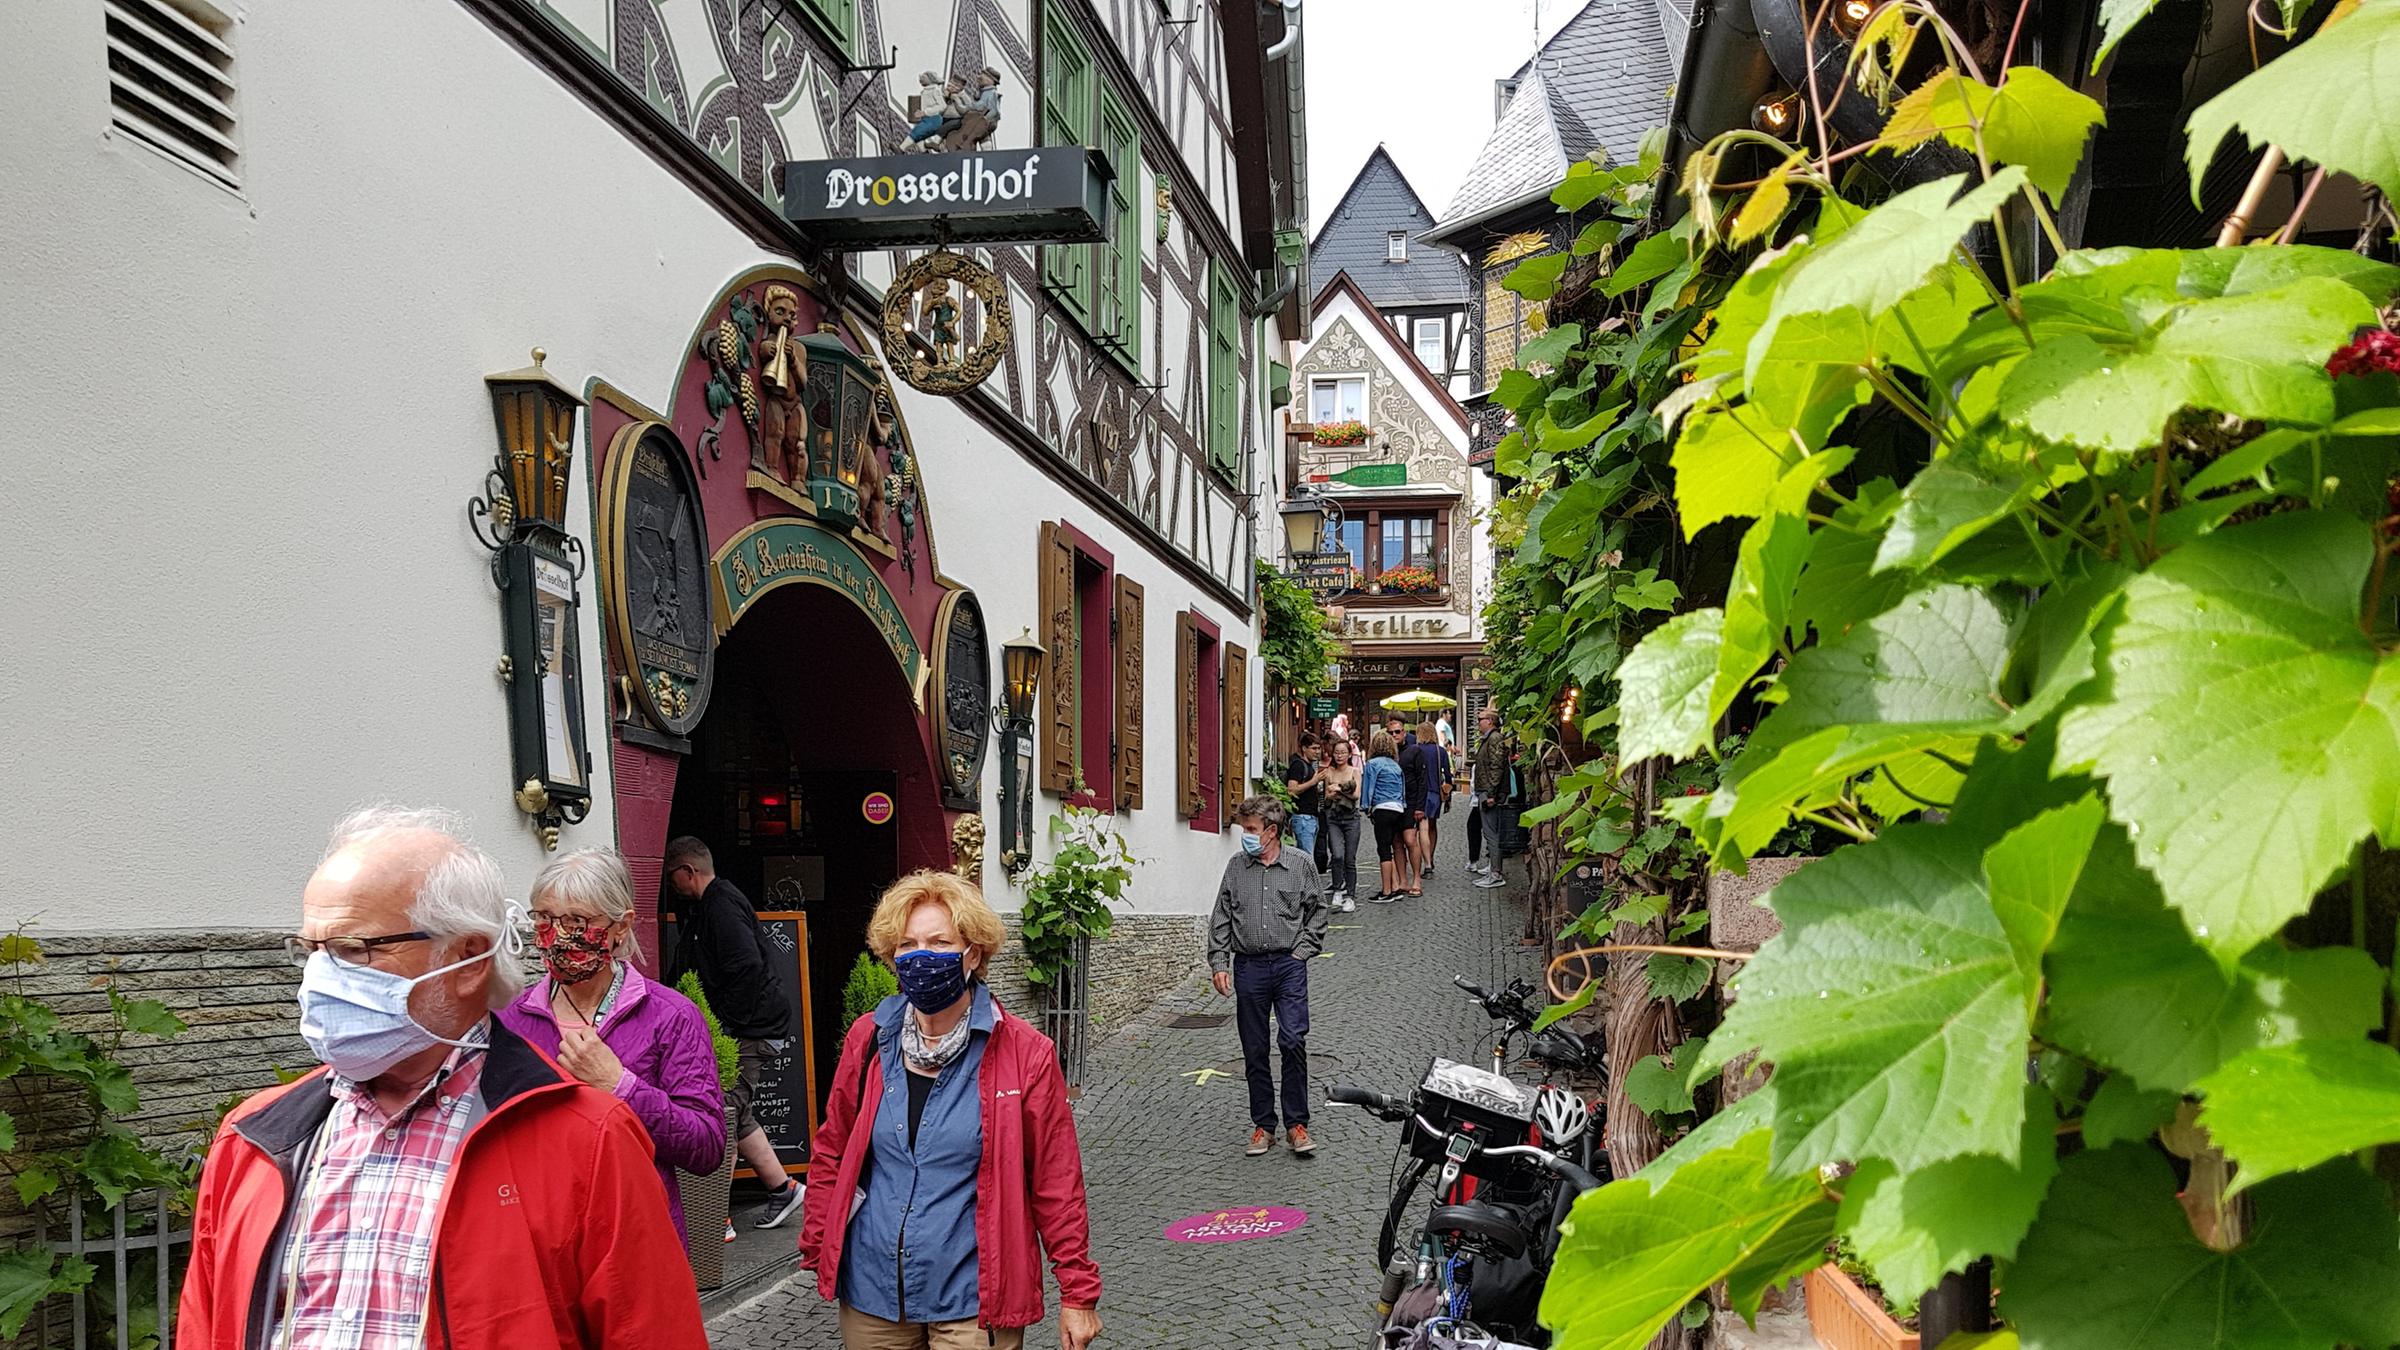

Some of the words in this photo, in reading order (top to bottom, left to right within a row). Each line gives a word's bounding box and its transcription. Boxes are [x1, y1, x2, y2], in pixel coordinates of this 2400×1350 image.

[825, 154, 1041, 209] Drosselhof
[832, 556, 842, 580] in
[844, 563, 860, 594] der
[1305, 577, 1319, 588] Art
[1322, 575, 1343, 588] Café
[1363, 664, 1390, 672] CAFE
[763, 1124, 790, 1133] RTE
[1182, 1221, 1283, 1235] ABSTAND
[1187, 1227, 1271, 1239] HALTEN
